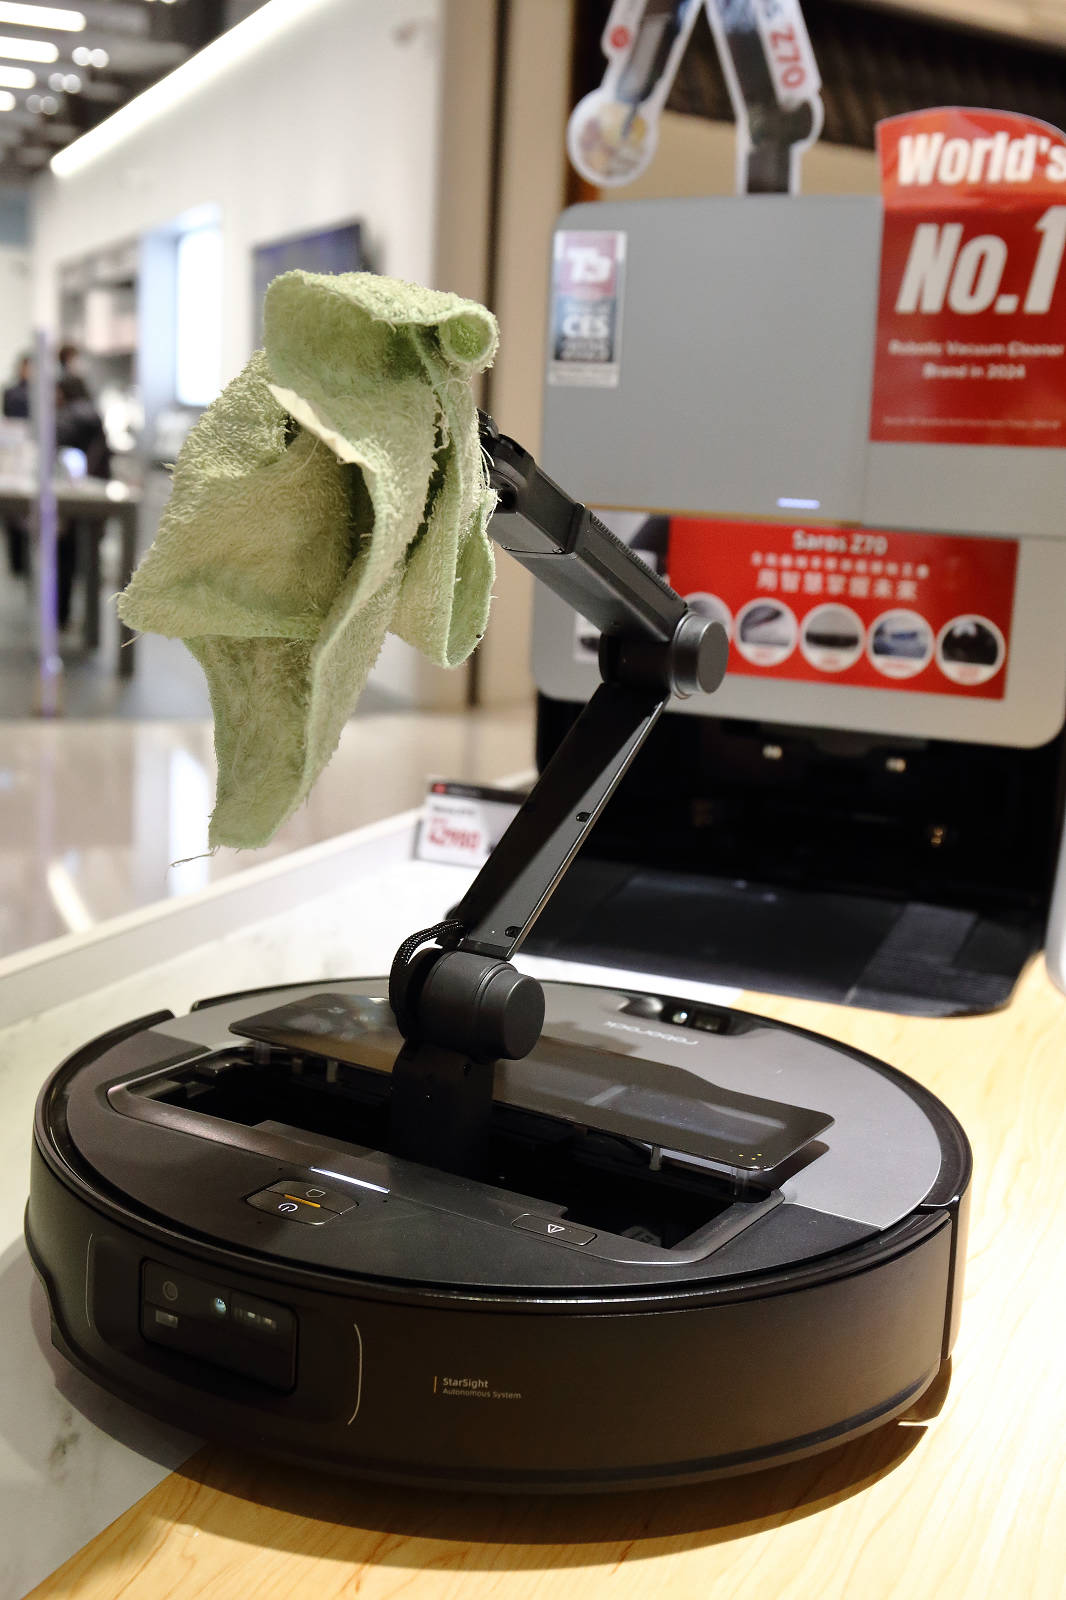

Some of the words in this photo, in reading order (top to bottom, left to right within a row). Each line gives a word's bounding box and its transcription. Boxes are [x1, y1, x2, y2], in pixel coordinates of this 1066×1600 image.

[770, 25, 806, 89] Z70
[895, 206, 1066, 314] No.1
[888, 340, 942, 355] Robotic
[946, 341, 1005, 356] Vacuum
[1007, 342, 1065, 357] Cleaner
[923, 362, 967, 378] Brand
[793, 531, 847, 552] Saros
[850, 534, 887, 555] Z70
[443, 1377, 488, 1389] StarSight
[443, 1387, 491, 1398] Autonomous
[492, 1391, 521, 1399] System
